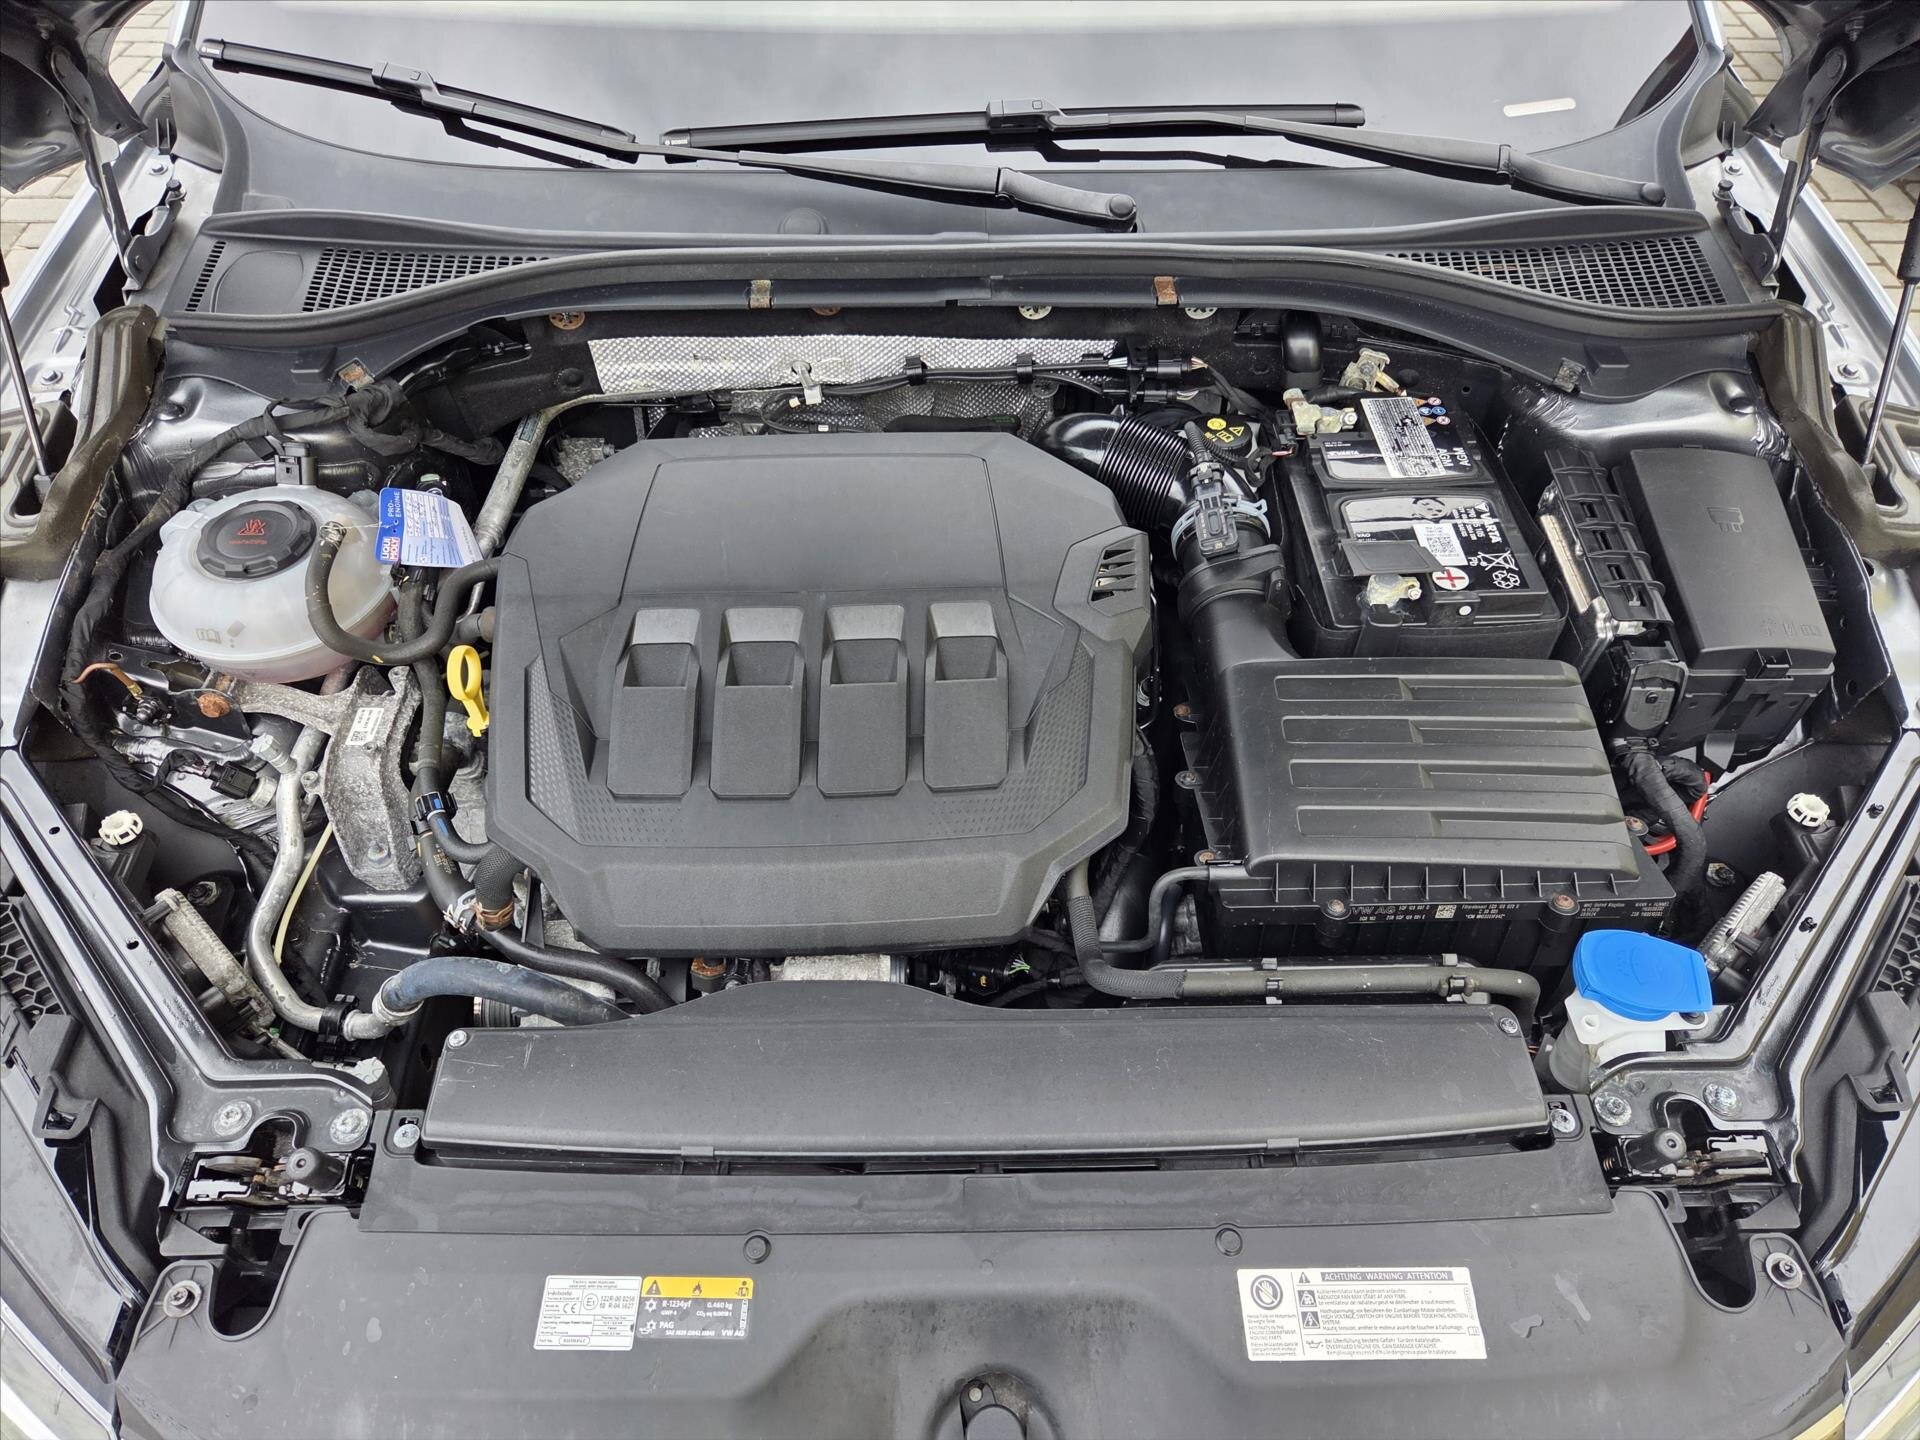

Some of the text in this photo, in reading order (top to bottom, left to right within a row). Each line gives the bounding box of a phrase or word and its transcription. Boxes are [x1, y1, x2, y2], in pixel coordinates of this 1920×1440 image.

[1438, 448, 1454, 467] AGM
[1454, 447, 1471, 466] AGM
[1480, 512, 1502, 543] VARTA
[382, 538, 390, 559] LIQUI
[390, 538, 399, 560] MOLY
[1468, 556, 1478, 566] Pb
[1324, 1271, 1449, 1280] ACHTUNG WARNING ATTENTION
[662, 1300, 692, 1309] R-1234yf
